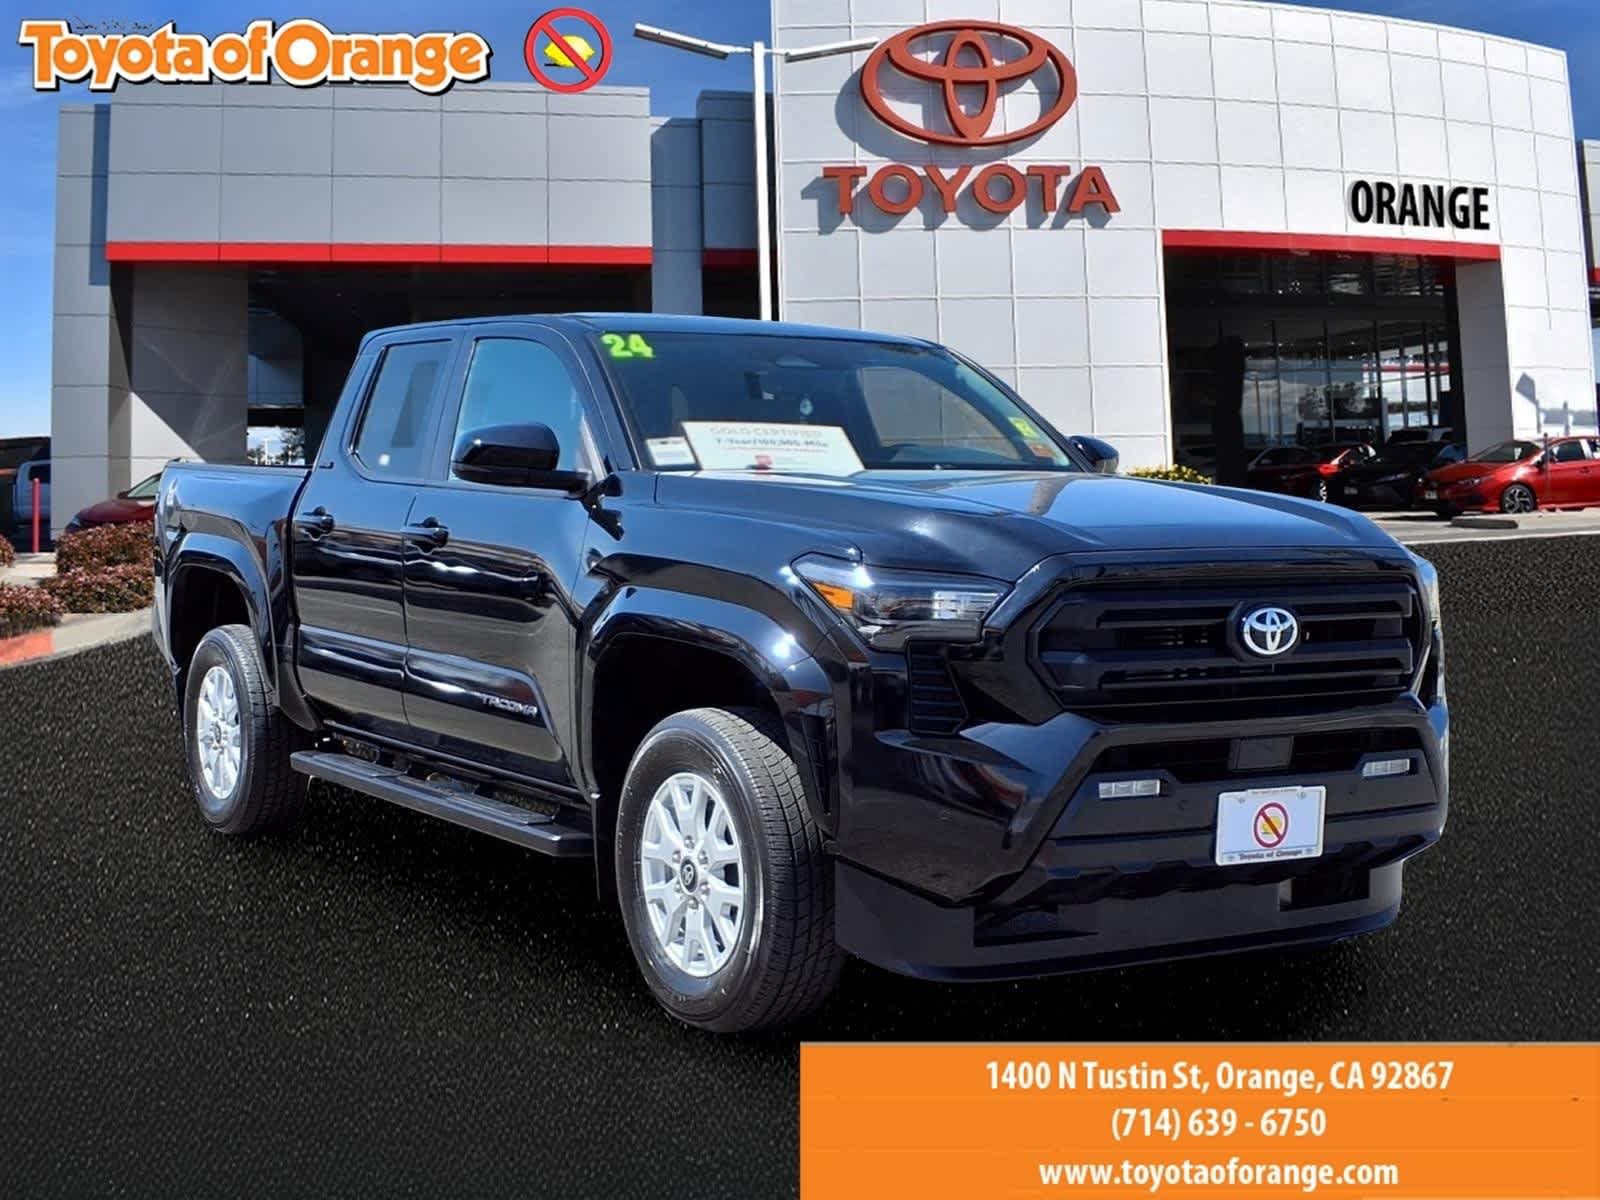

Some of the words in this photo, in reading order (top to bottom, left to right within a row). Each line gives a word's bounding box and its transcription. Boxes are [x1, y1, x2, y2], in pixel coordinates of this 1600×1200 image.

[823, 164, 1120, 216] TOYOTA
[1350, 180, 1490, 230] ORANGE
[600, 333, 654, 359] 24
[481, 693, 538, 717] TACOMA
